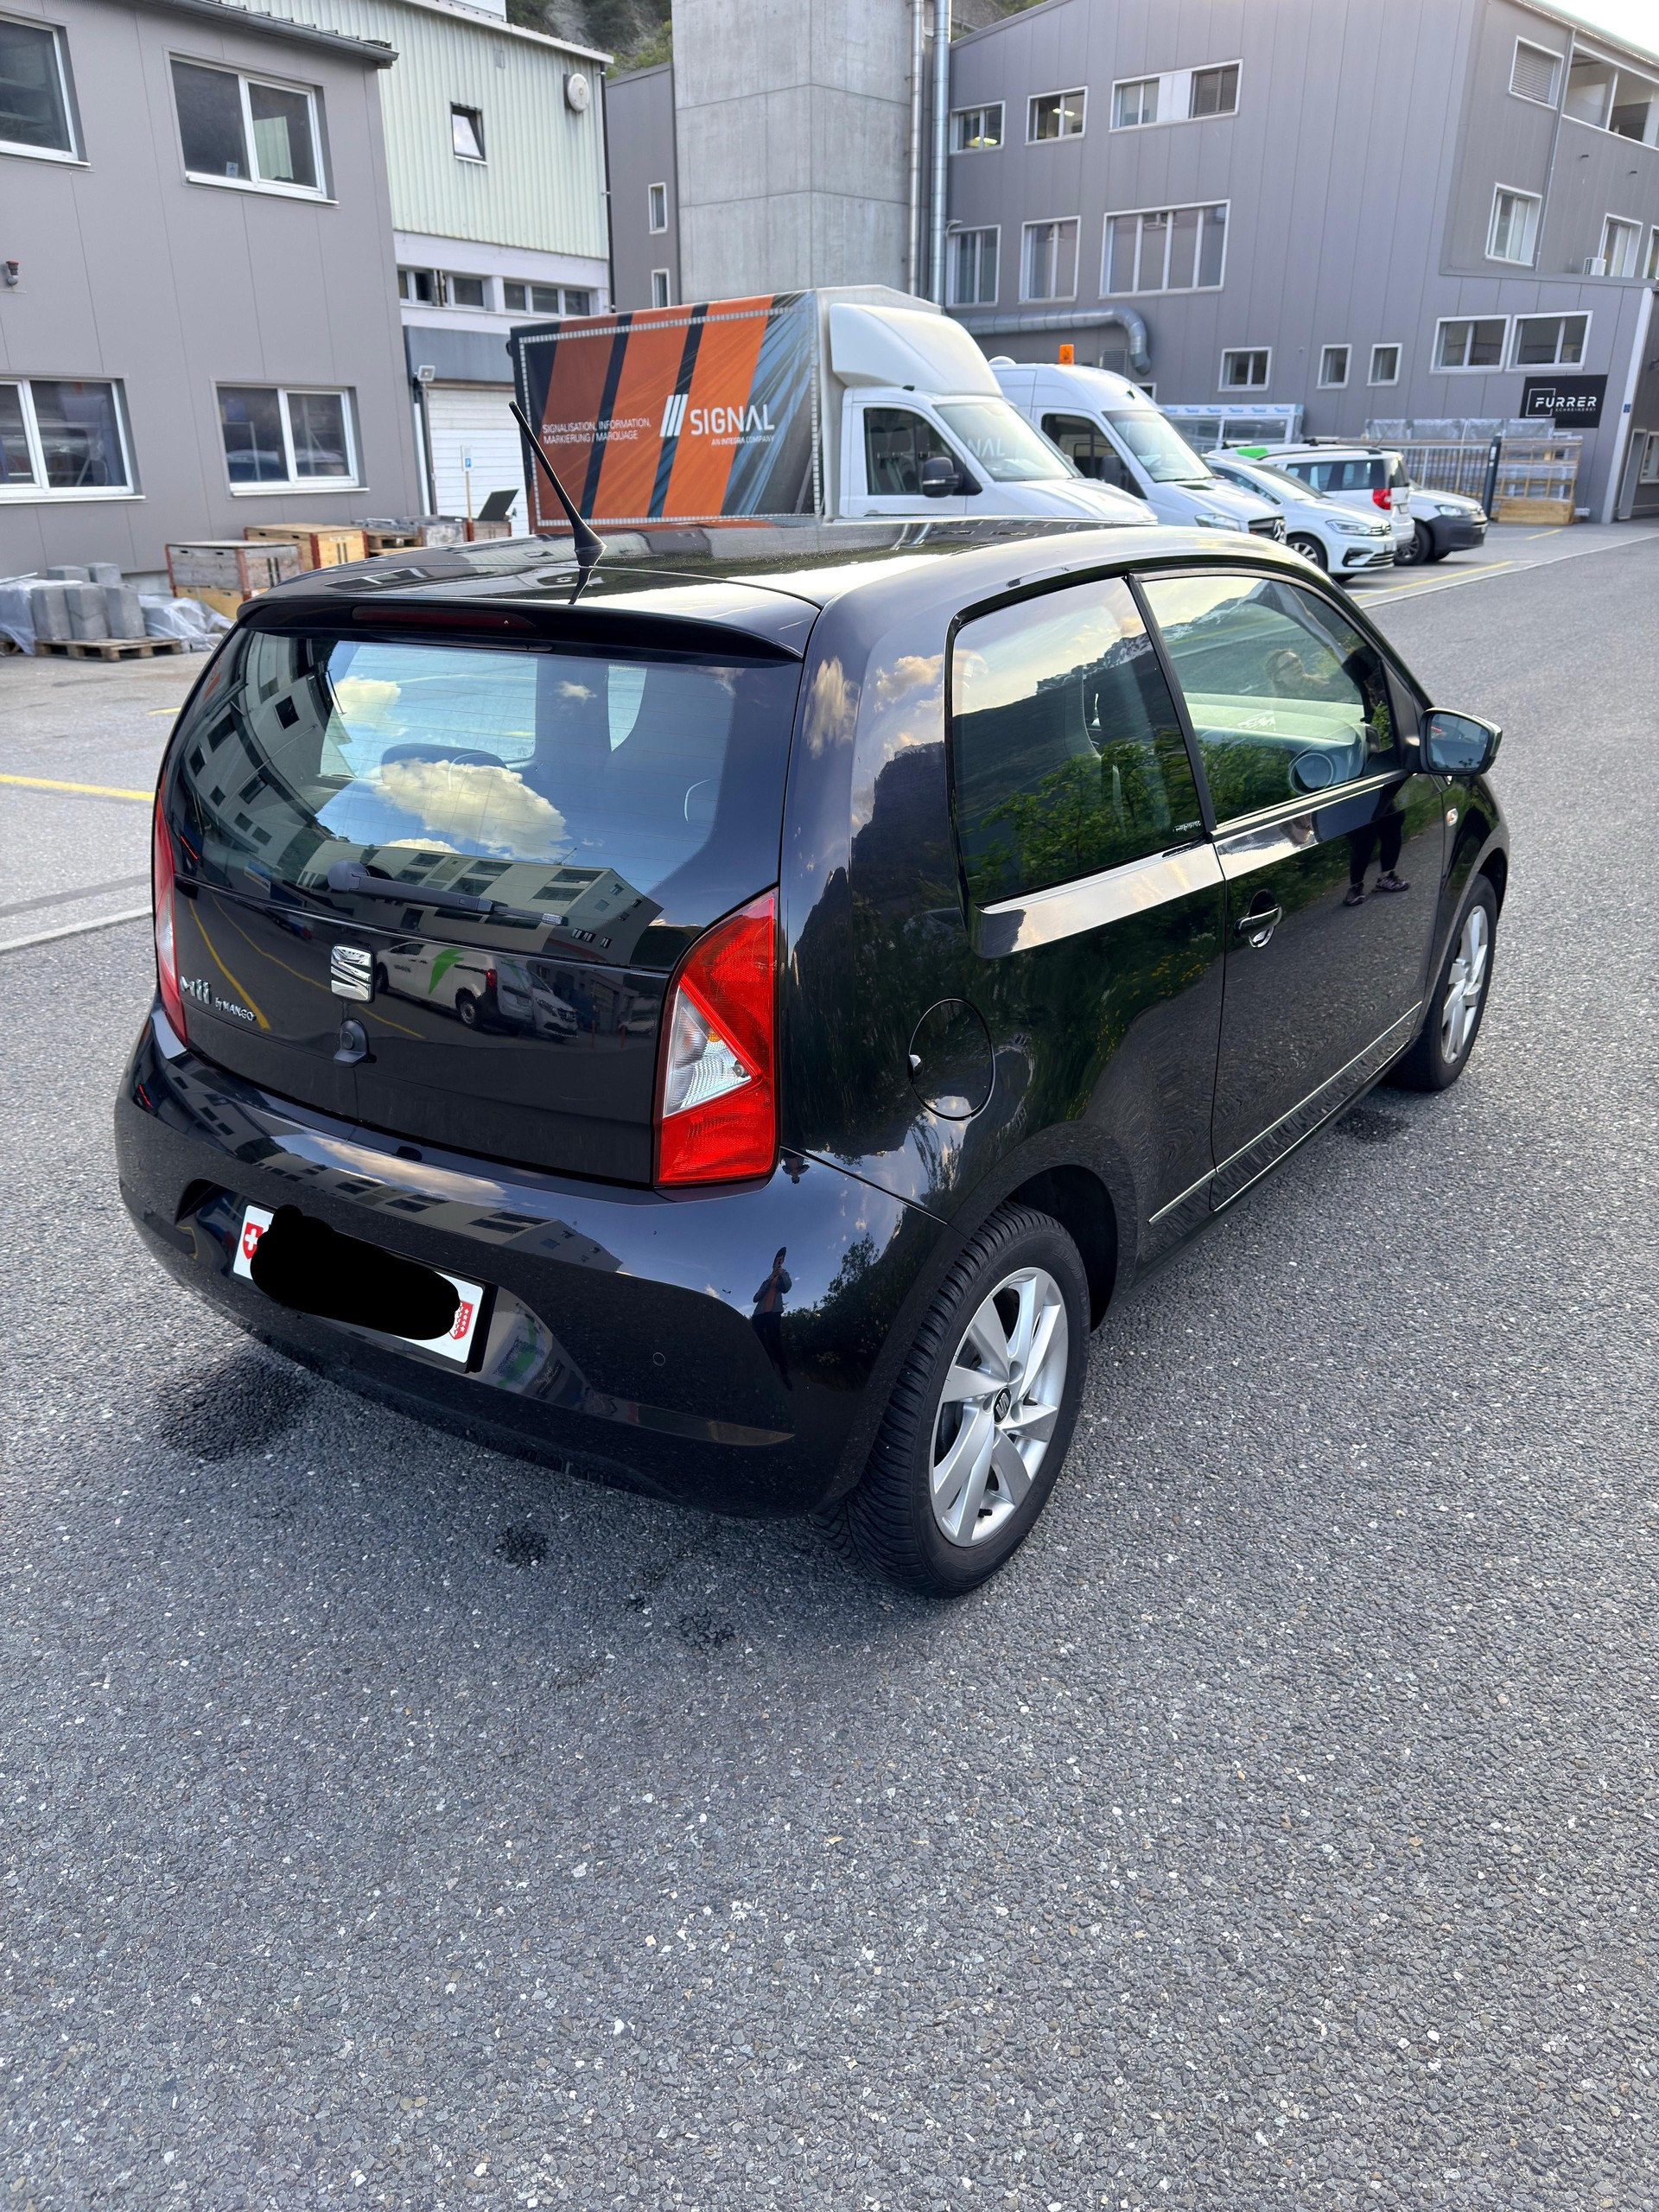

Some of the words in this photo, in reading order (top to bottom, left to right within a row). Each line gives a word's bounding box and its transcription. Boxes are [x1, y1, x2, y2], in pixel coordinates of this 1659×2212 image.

[1535, 396, 1597, 408] FURRER
[690, 404, 775, 435] SIGNAL
[543, 433, 591, 444] MARKIERUNG
[595, 429, 639, 442] MARQUAGE
[223, 1001, 256, 1021] MANGO
